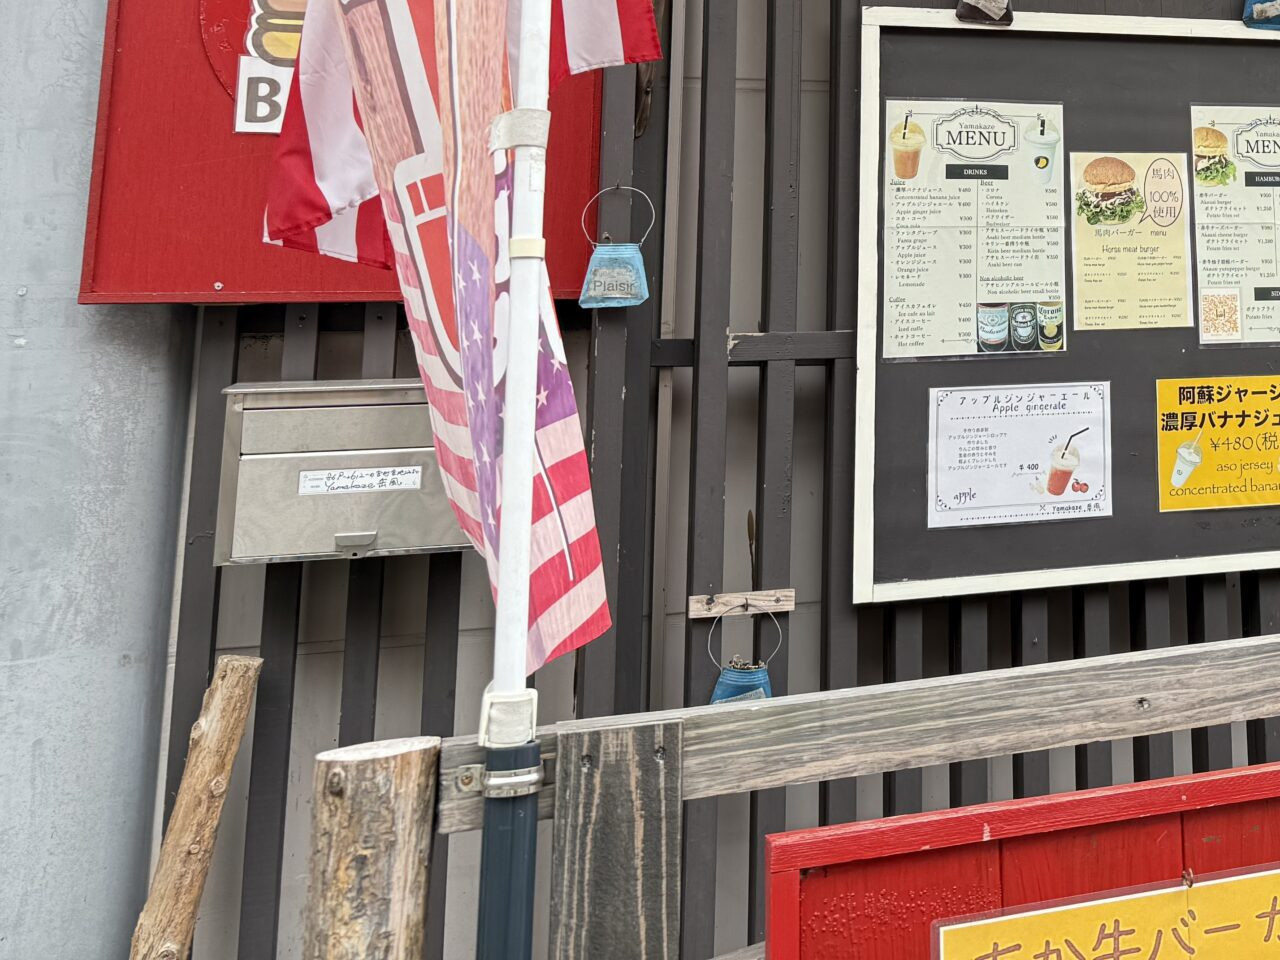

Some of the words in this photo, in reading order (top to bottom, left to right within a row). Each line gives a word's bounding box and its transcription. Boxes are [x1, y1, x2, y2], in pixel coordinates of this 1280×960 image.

[959, 122, 995, 130] Yamakaze
[946, 131, 1006, 147] MENU
[1152, 168, 1175, 179] 馬肉
[1150, 191, 1179, 203] 100%
[1153, 206, 1176, 218] 使用
[1094, 228, 1142, 237] 馬肉バーガー
[1102, 245, 1121, 253] Horse
[1140, 245, 1160, 254] burger
[594, 280, 634, 291] Plaisir
[960, 392, 1090, 405] アップルジンジャーエール
[993, 403, 1019, 413] Apple
[1026, 402, 1066, 413] gingerale
[1216, 461, 1238, 472] aso
[1239, 459, 1273, 478] jersey
[1169, 478, 1248, 497] concentrated
[953, 488, 977, 505] apple
[1053, 504, 1082, 512] Yamakaze
